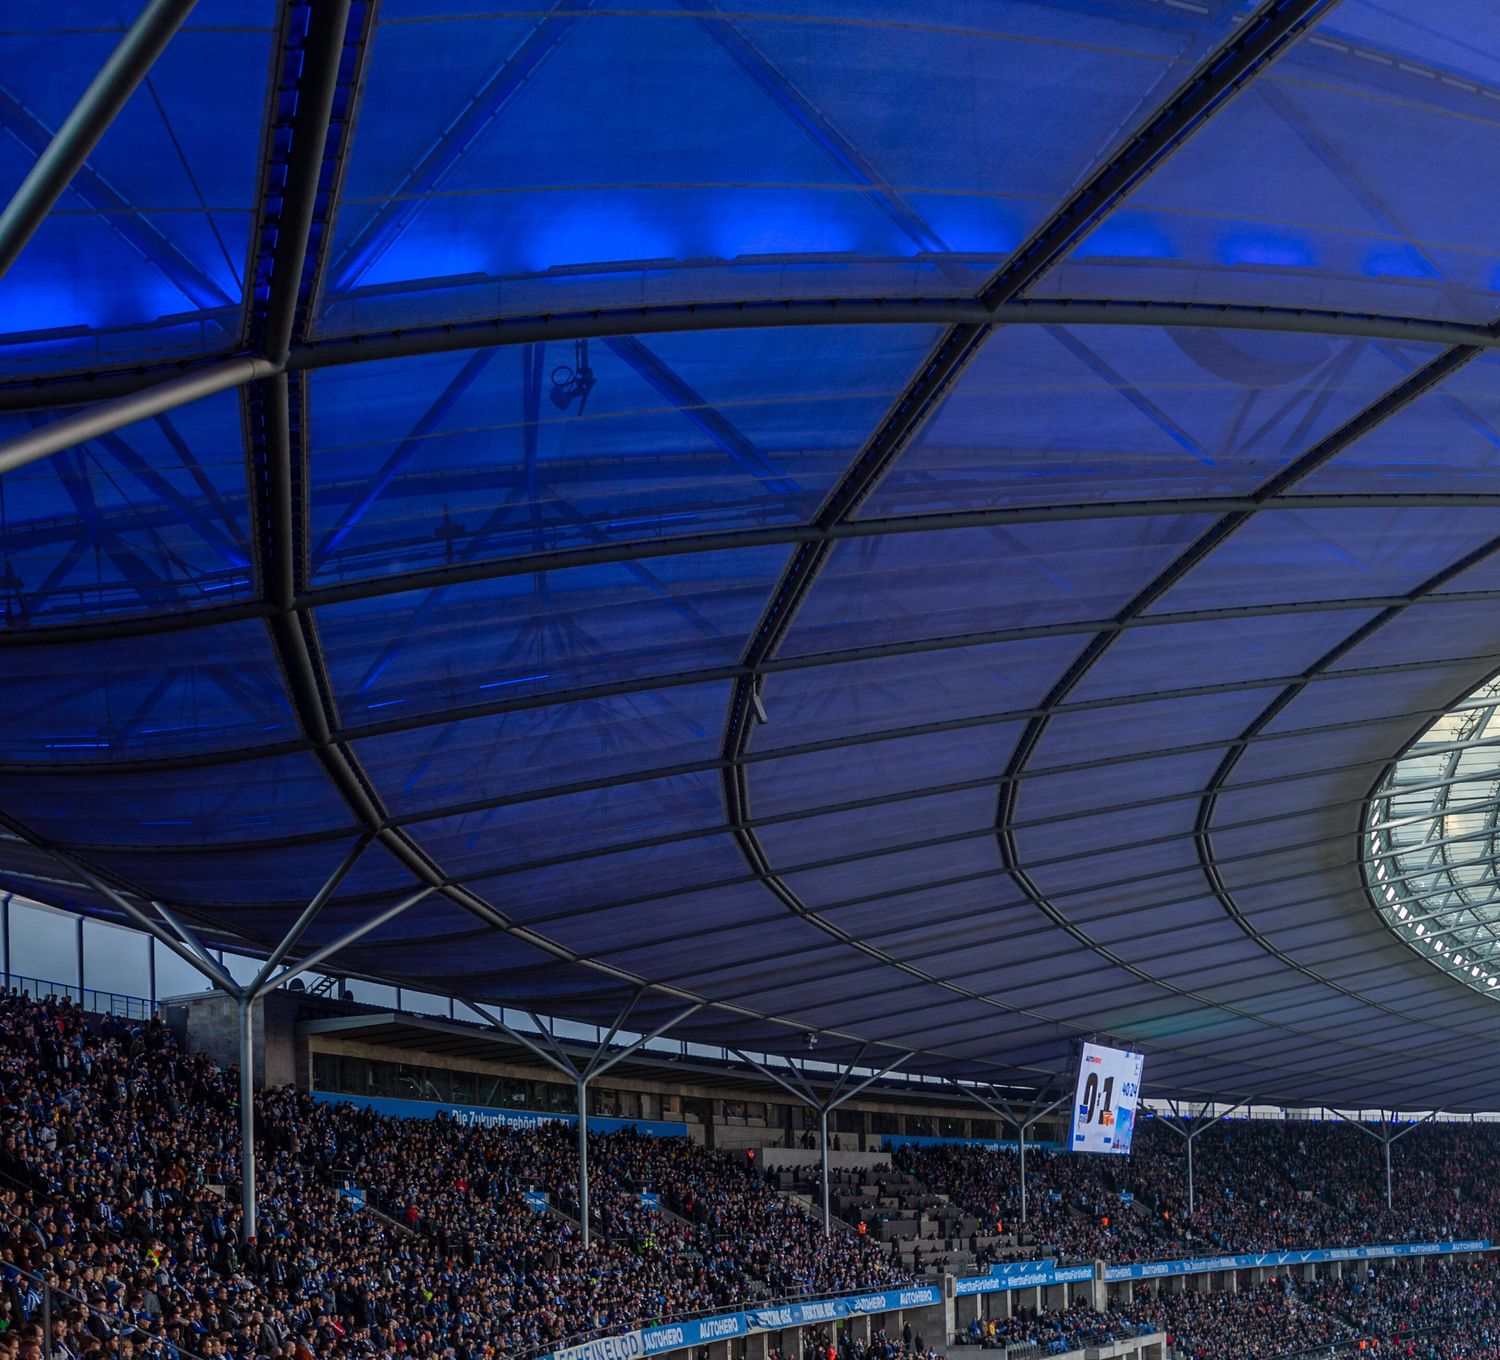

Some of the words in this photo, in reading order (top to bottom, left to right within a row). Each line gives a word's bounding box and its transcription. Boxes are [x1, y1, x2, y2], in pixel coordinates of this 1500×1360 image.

[469, 1111, 506, 1128] Zukunft
[507, 1114, 537, 1131] gehört
[900, 1289, 933, 1305] AUTOHERO
[643, 1327, 684, 1351] AUTOHERO
[700, 1317, 739, 1341] AUTOHERO
